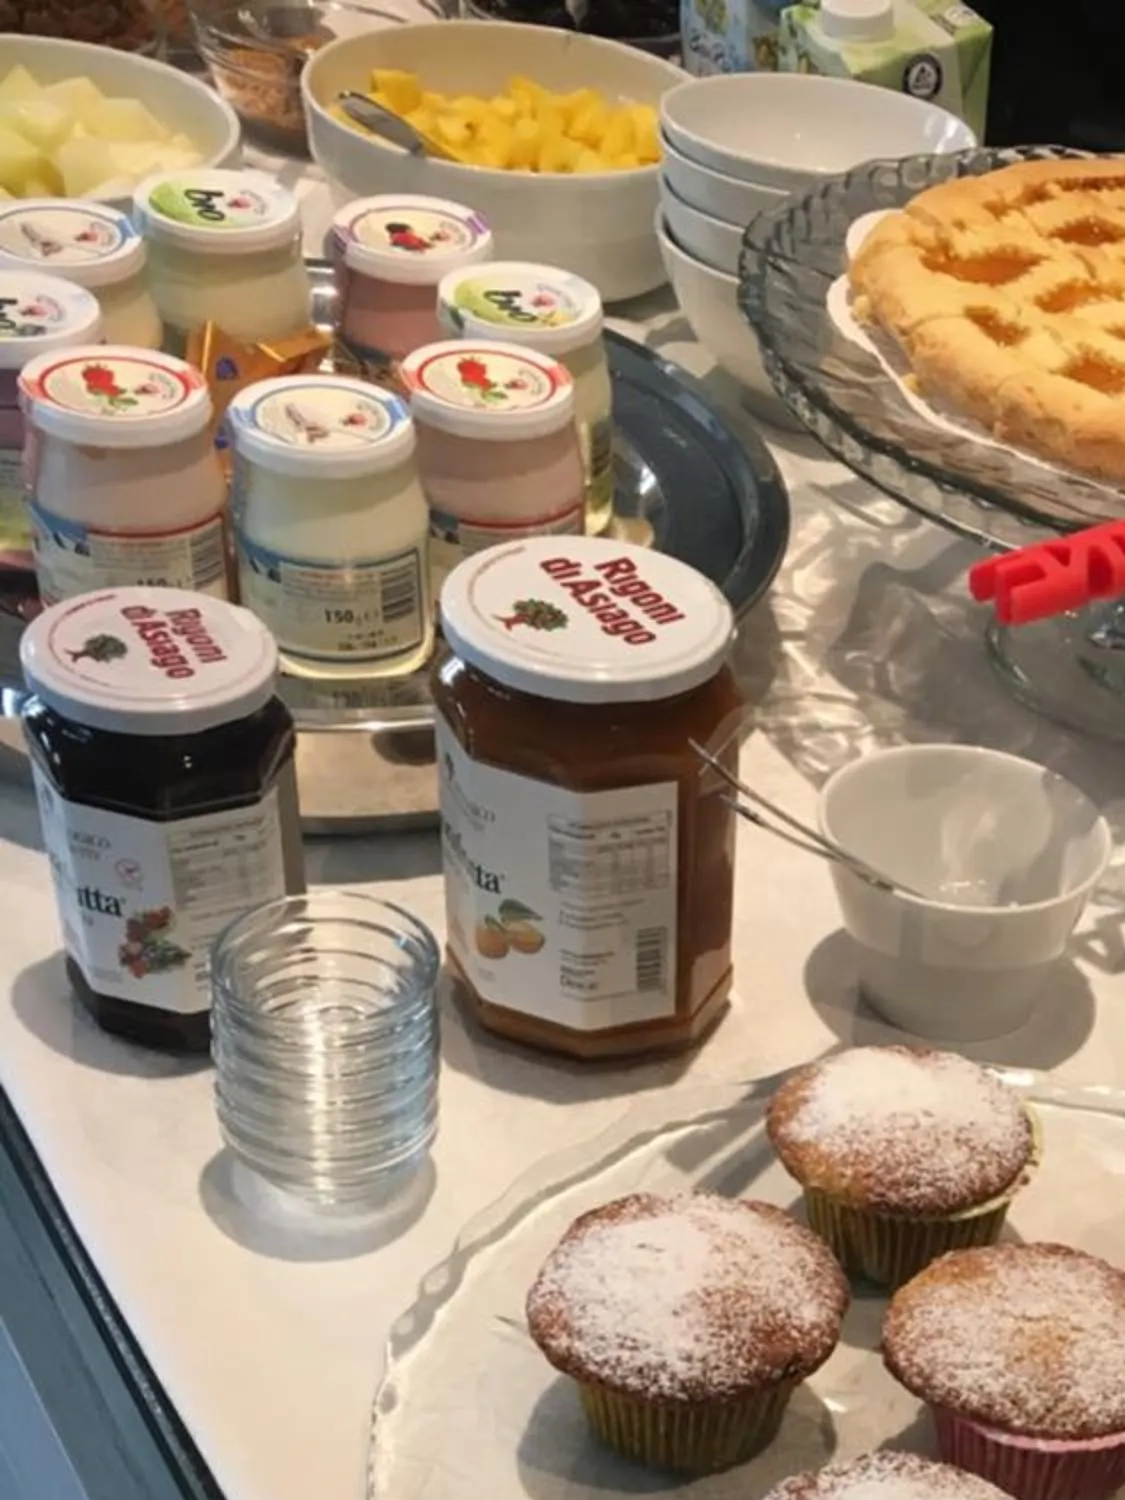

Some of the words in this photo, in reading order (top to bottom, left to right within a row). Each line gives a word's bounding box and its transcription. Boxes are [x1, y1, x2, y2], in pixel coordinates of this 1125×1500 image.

[560, 579, 657, 645] Asiago
[594, 557, 686, 625] Rigoni
[131, 621, 195, 679] Asiago
[165, 608, 228, 663] Rigoni
